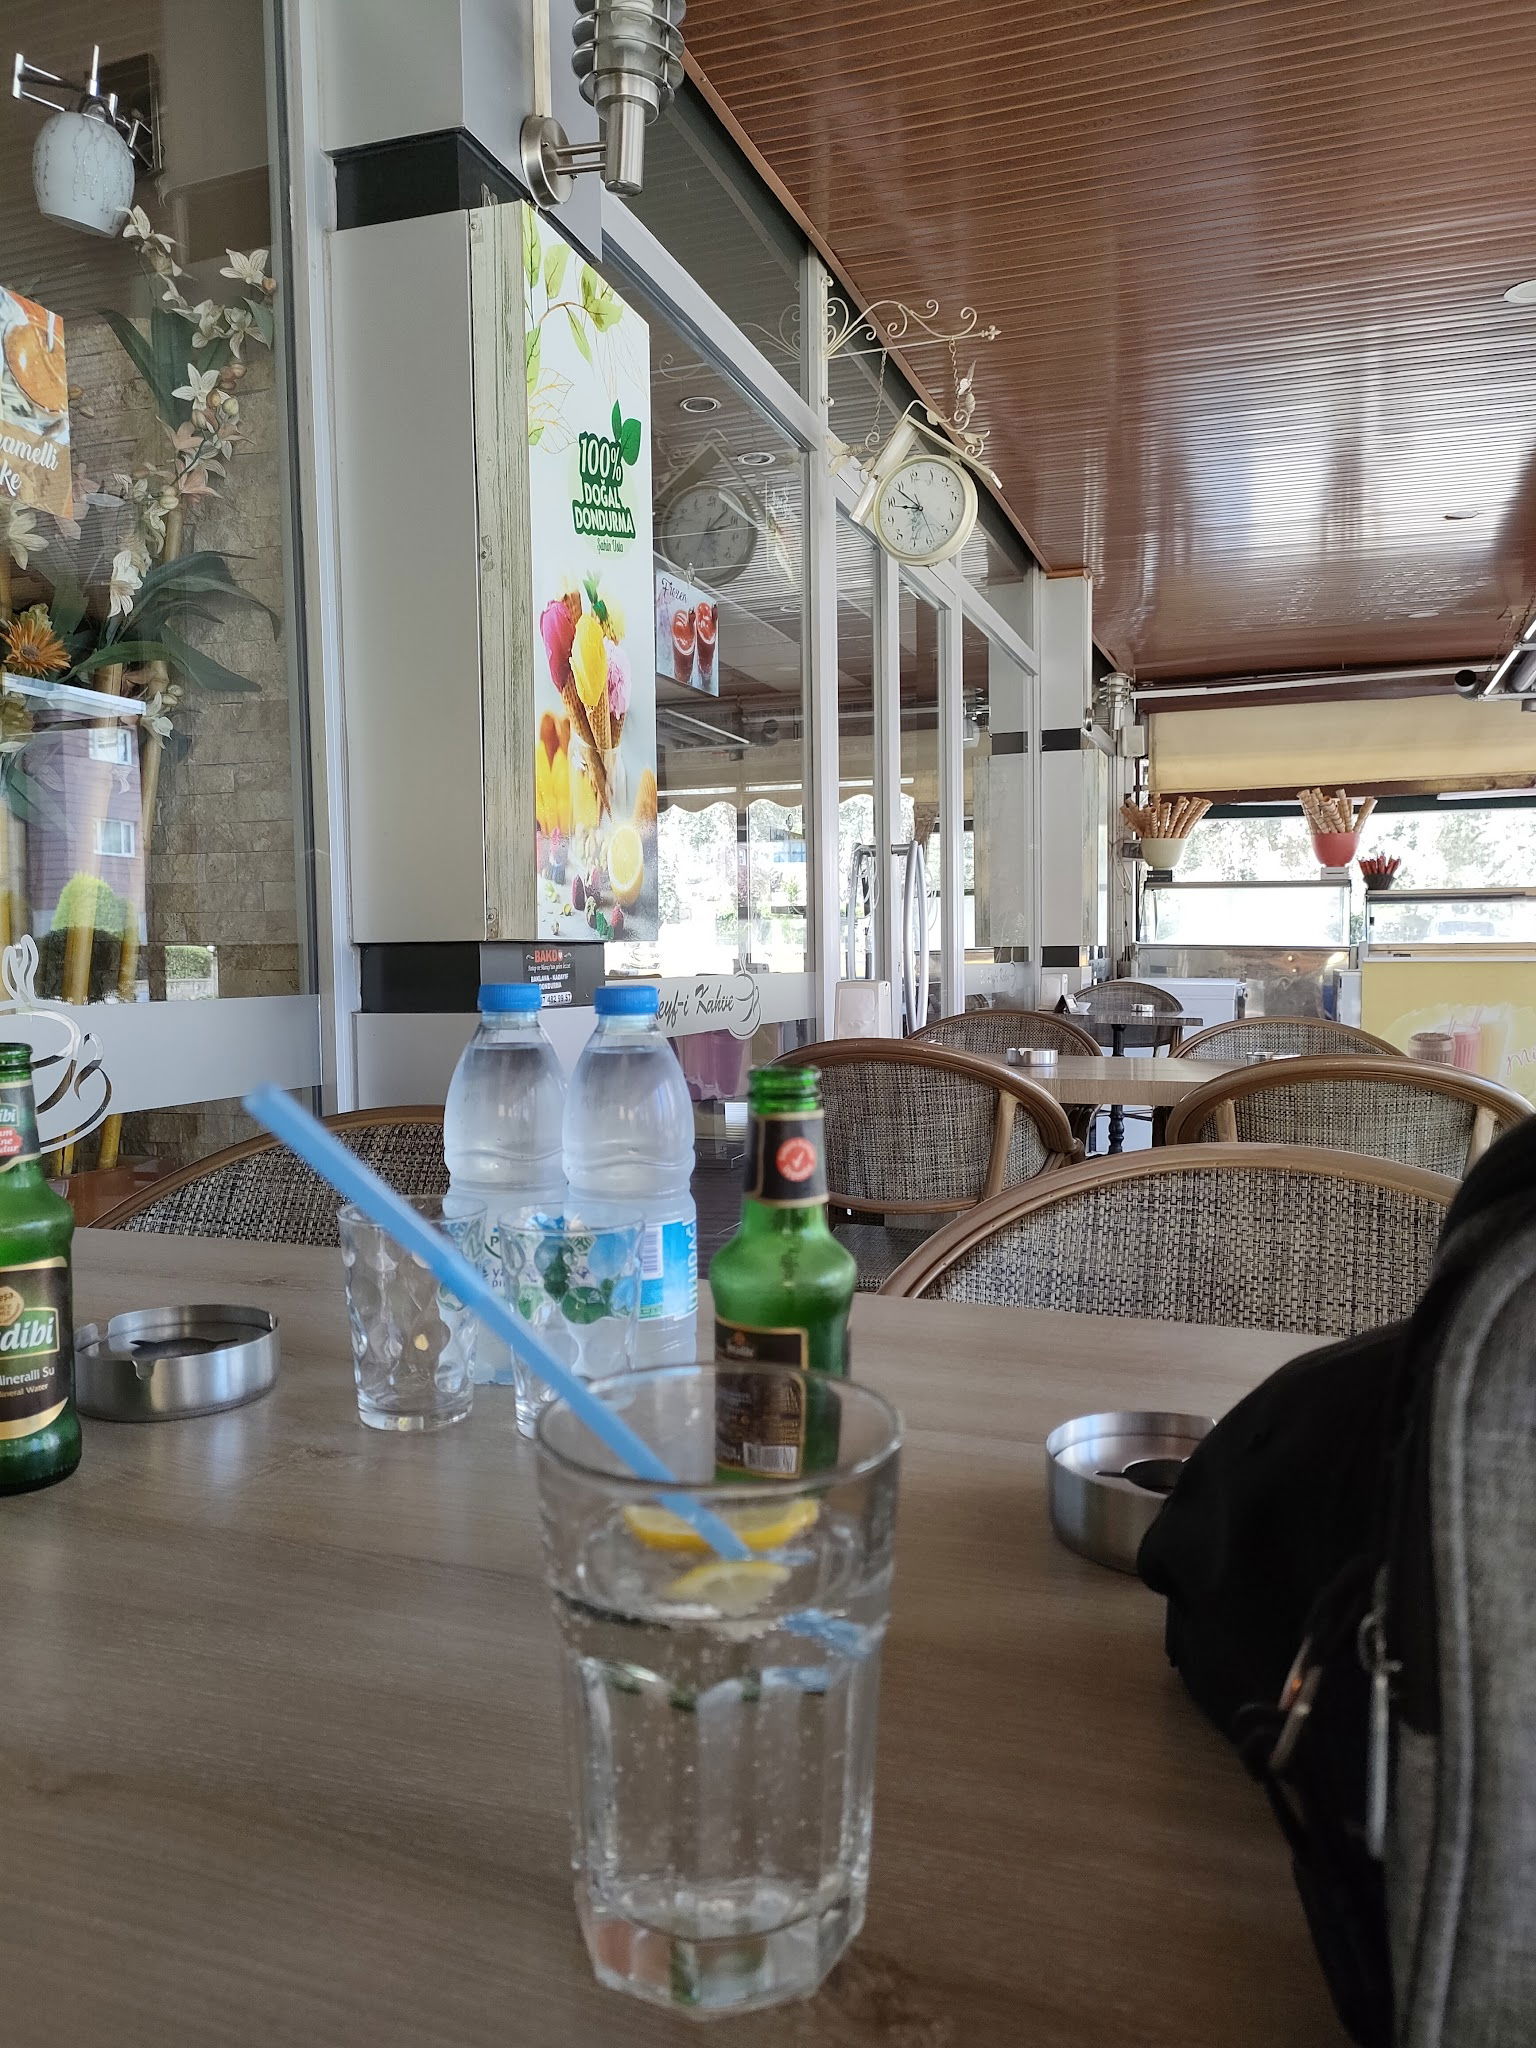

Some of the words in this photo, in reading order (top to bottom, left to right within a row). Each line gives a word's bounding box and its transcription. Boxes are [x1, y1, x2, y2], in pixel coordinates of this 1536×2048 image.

[581, 439, 622, 481] 100%
[584, 479, 622, 509] DOĞAL
[574, 506, 634, 534] DONDURMA
[42, 1366, 55, 1378] Su
